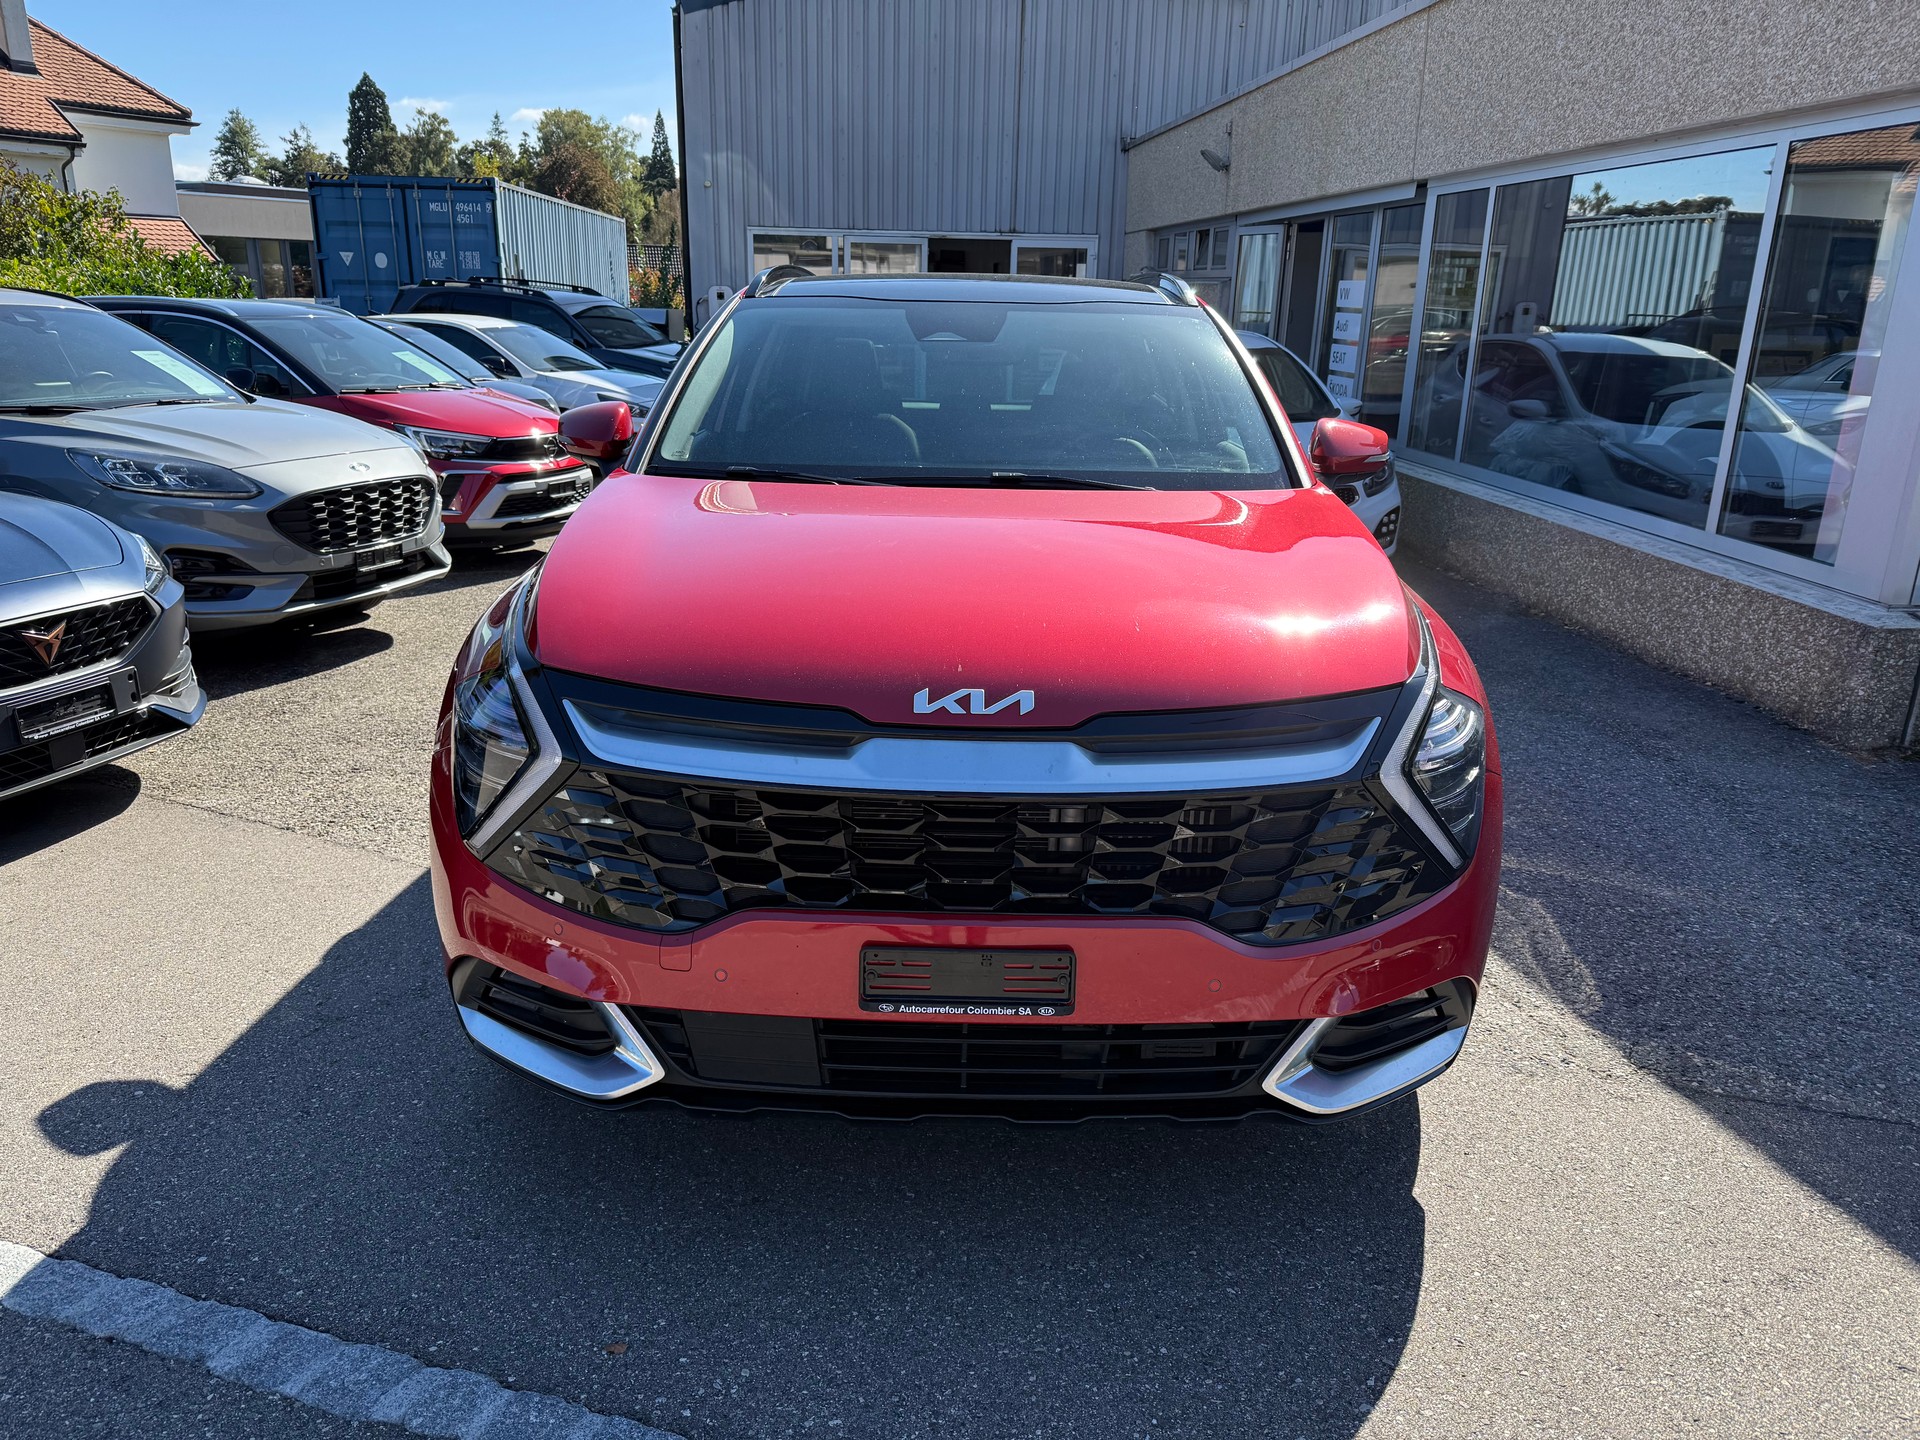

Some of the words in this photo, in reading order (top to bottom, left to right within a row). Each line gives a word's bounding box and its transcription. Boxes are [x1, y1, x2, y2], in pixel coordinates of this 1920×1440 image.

[429, 202, 448, 212] MGLU
[455, 202, 481, 213] 496414
[456, 214, 474, 223] 45G1
[428, 259, 444, 268] TARE
[1340, 287, 1351, 300] VW
[1335, 319, 1349, 333] Audi
[1332, 351, 1347, 364] SEAT
[1329, 379, 1348, 397] ŠKODA
[913, 687, 1034, 716] KIA
[899, 1004, 965, 1014] Autocarrefour
[967, 1006, 1016, 1015] Colombier
[1018, 1007, 1032, 1016] SA
[1039, 1007, 1054, 1015] KIA
